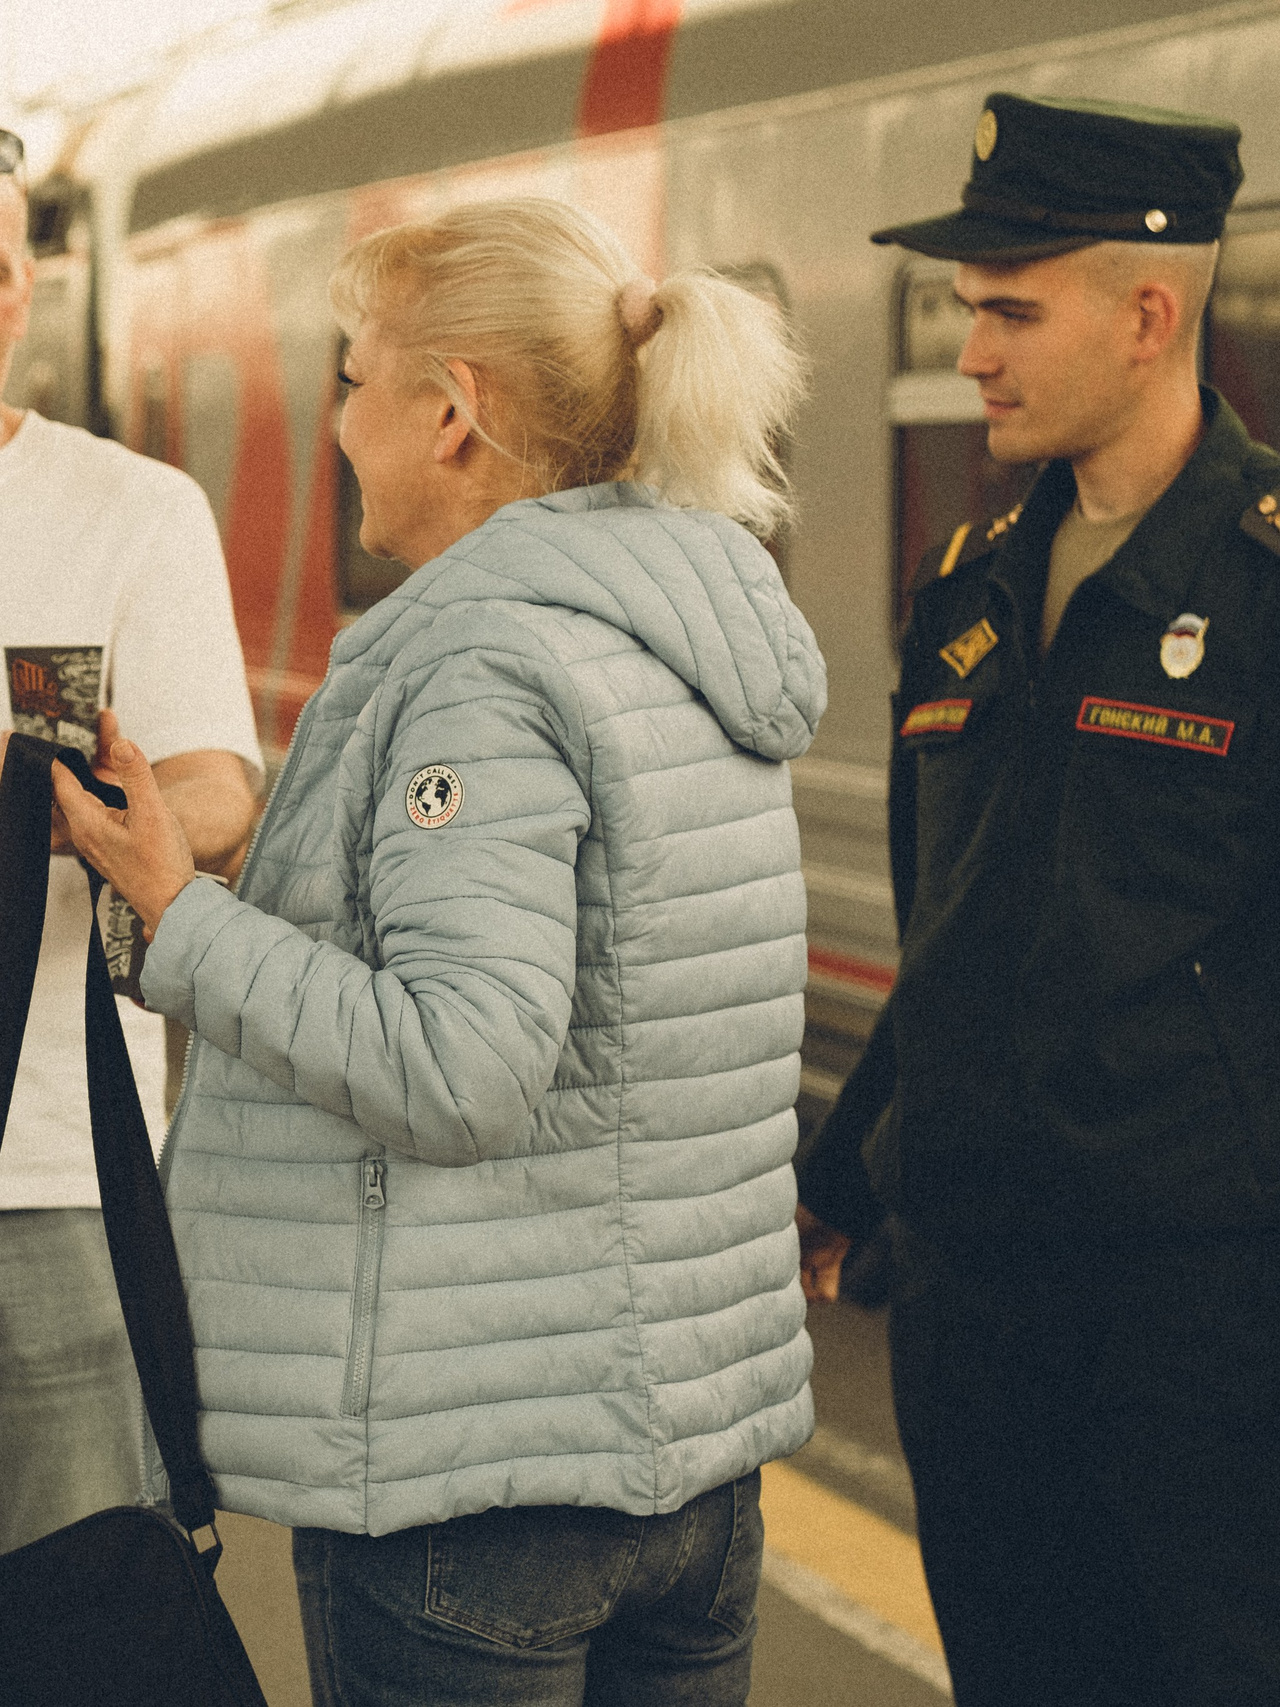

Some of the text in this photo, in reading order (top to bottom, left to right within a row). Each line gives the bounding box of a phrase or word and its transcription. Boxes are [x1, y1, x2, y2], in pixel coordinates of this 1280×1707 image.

[409, 773, 424, 799] DON'T
[447, 773, 456, 784] ME
[410, 806, 425, 823] ZERO
